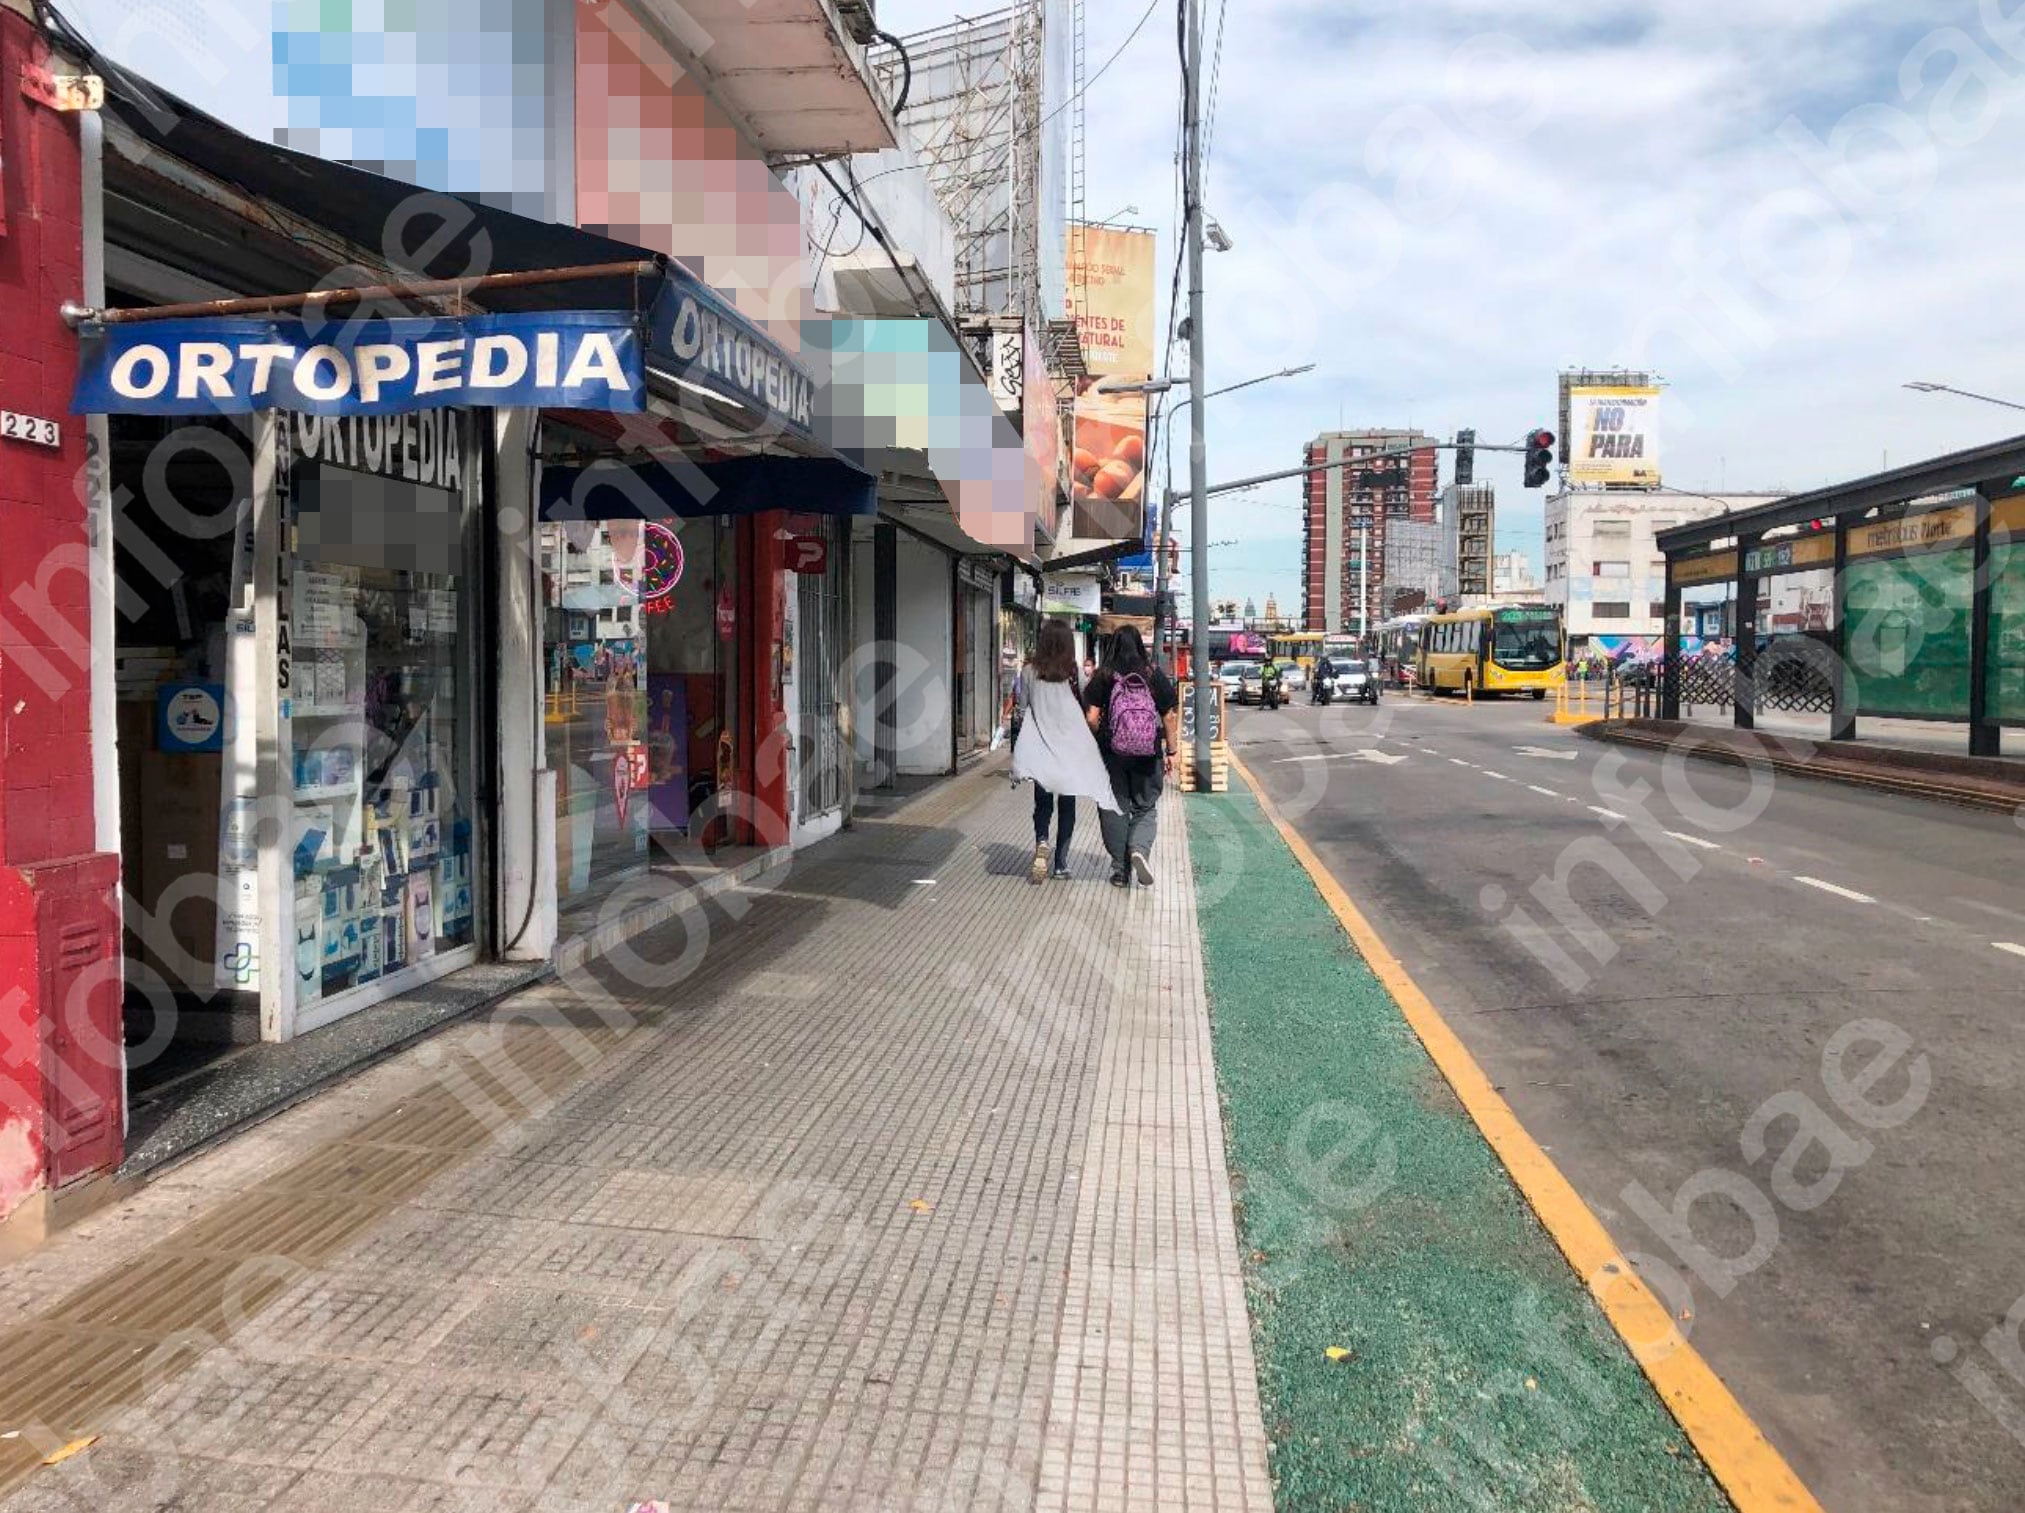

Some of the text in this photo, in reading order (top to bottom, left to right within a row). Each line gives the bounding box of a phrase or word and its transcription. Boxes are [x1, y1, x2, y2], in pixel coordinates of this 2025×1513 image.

[1110, 316, 1125, 331] DE
[1078, 332, 1125, 347] ATURAL
[110, 333, 631, 403] ORTOPEDIA
[671, 296, 812, 427] ORTOPEDIA
[5, 414, 56, 443] 223
[1593, 407, 1626, 431] NO
[1588, 434, 1645, 458] PARA
